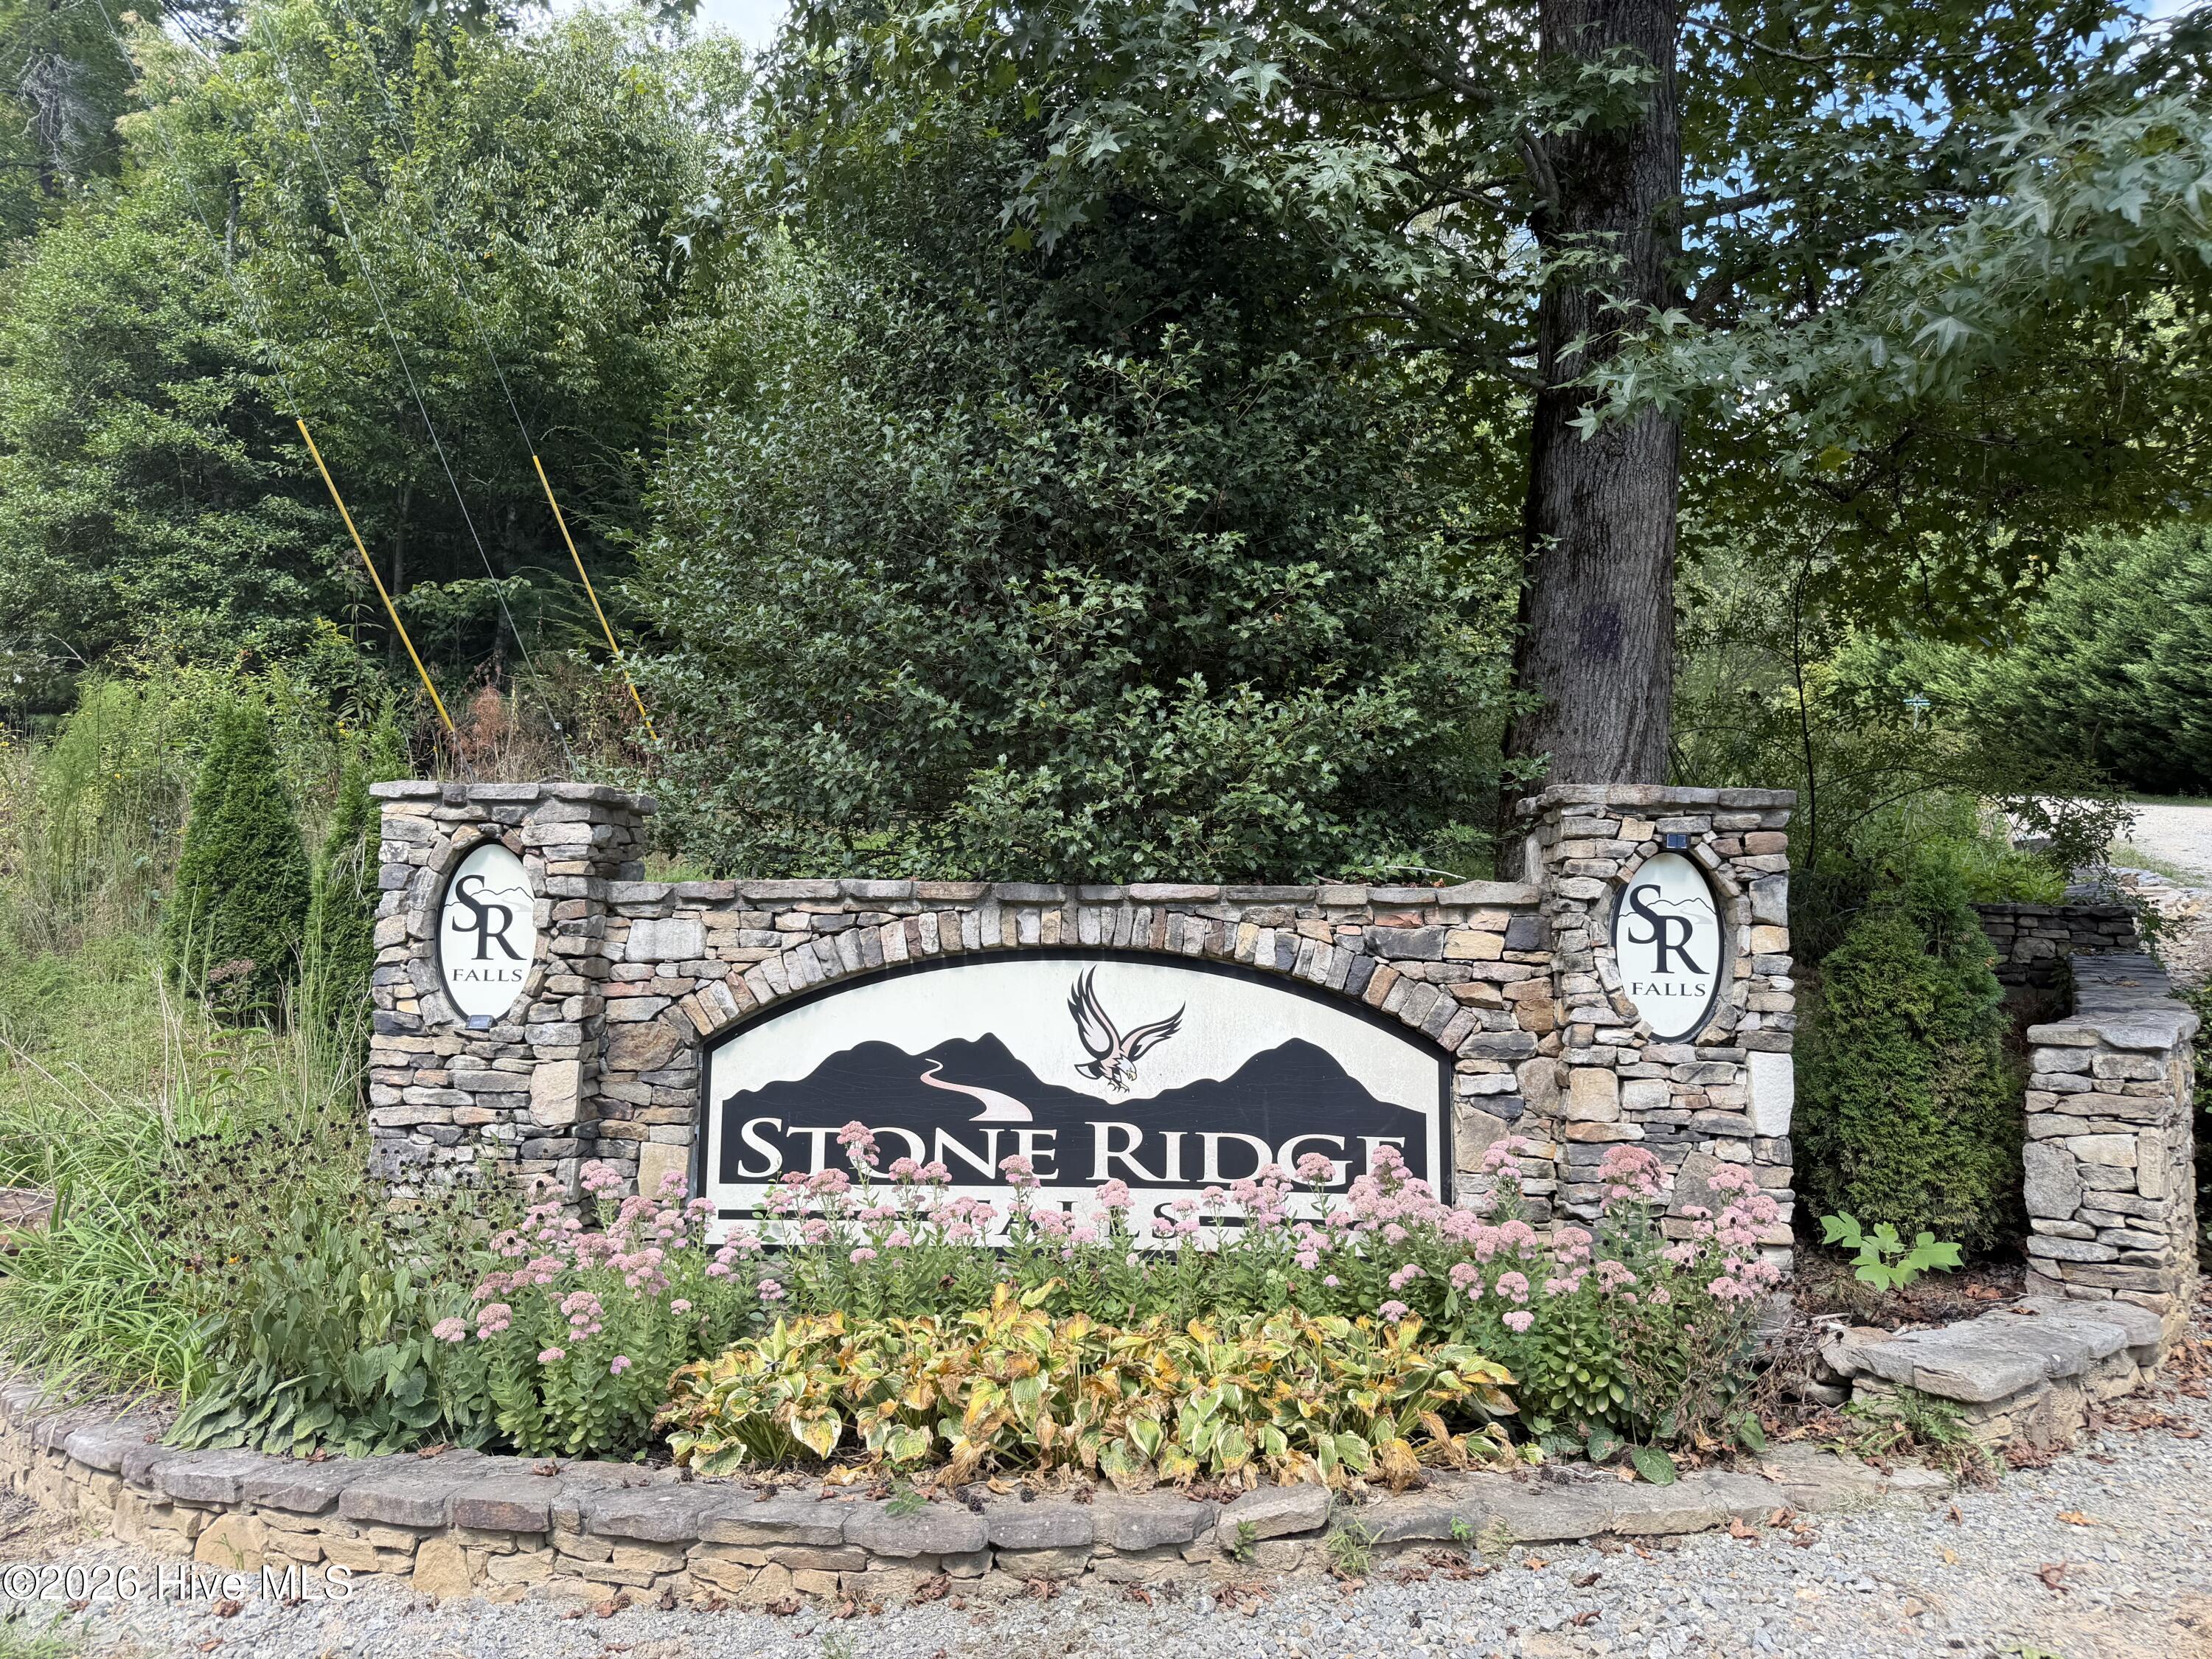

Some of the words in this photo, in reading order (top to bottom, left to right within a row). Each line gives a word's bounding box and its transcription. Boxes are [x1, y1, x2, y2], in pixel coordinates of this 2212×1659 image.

[451, 874, 527, 961] SR
[1628, 884, 1710, 975] SR
[452, 968, 523, 982] FALLS
[1630, 981, 1706, 997] FALLS
[737, 1117, 1060, 1180] STONE
